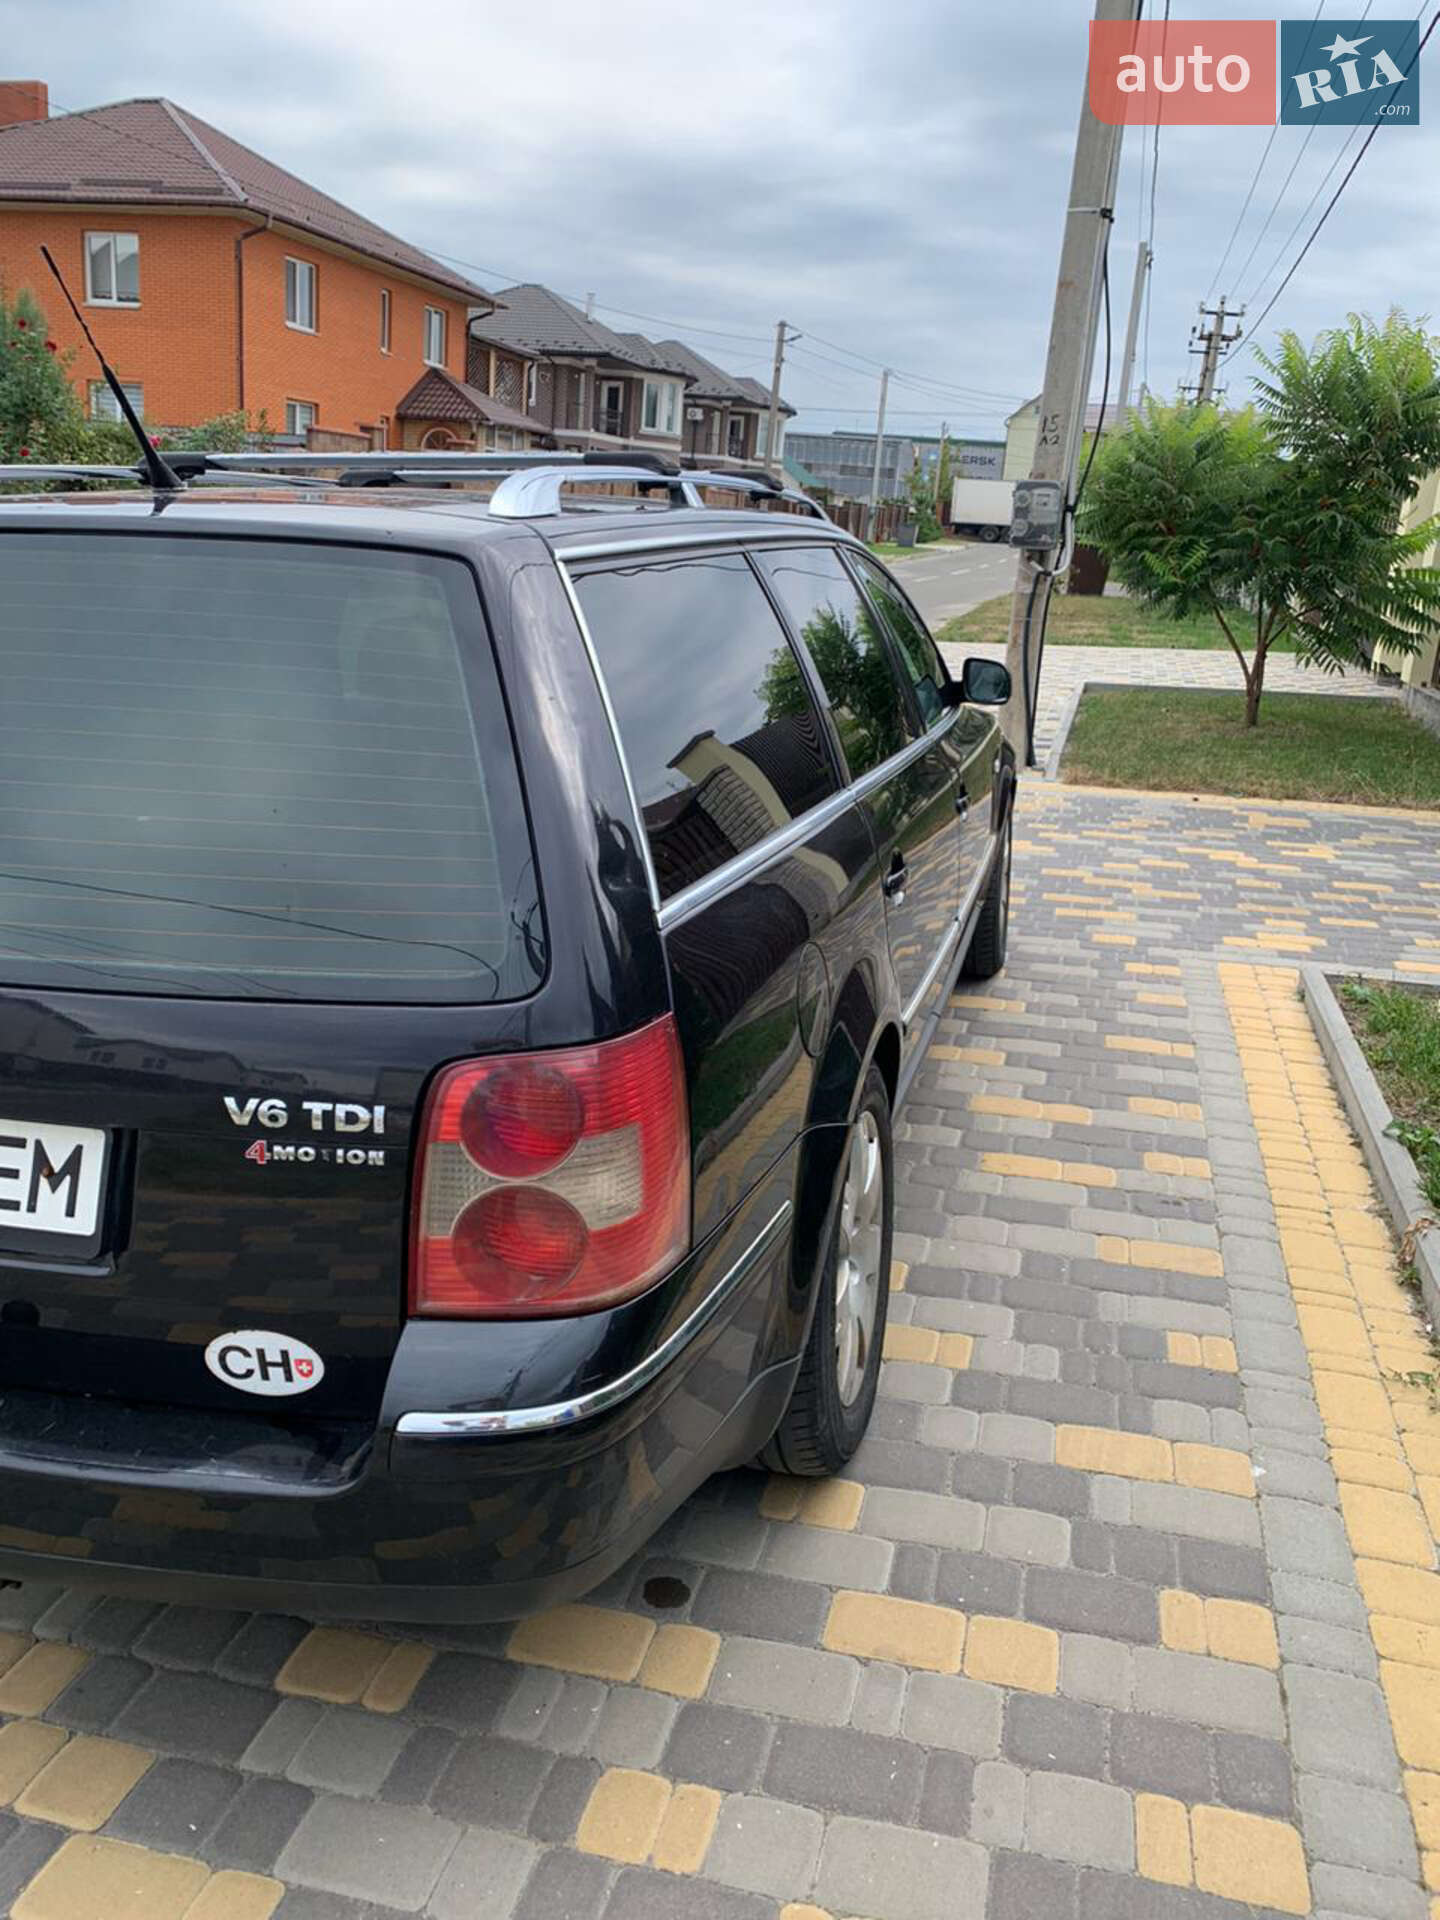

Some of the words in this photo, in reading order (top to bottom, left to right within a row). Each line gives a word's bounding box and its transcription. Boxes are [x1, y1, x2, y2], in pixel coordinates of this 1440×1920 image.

[1042, 413, 1060, 434] 15
[223, 1096, 288, 1128] V6
[302, 1101, 385, 1134] TDI
[218, 1345, 294, 1383] CH
